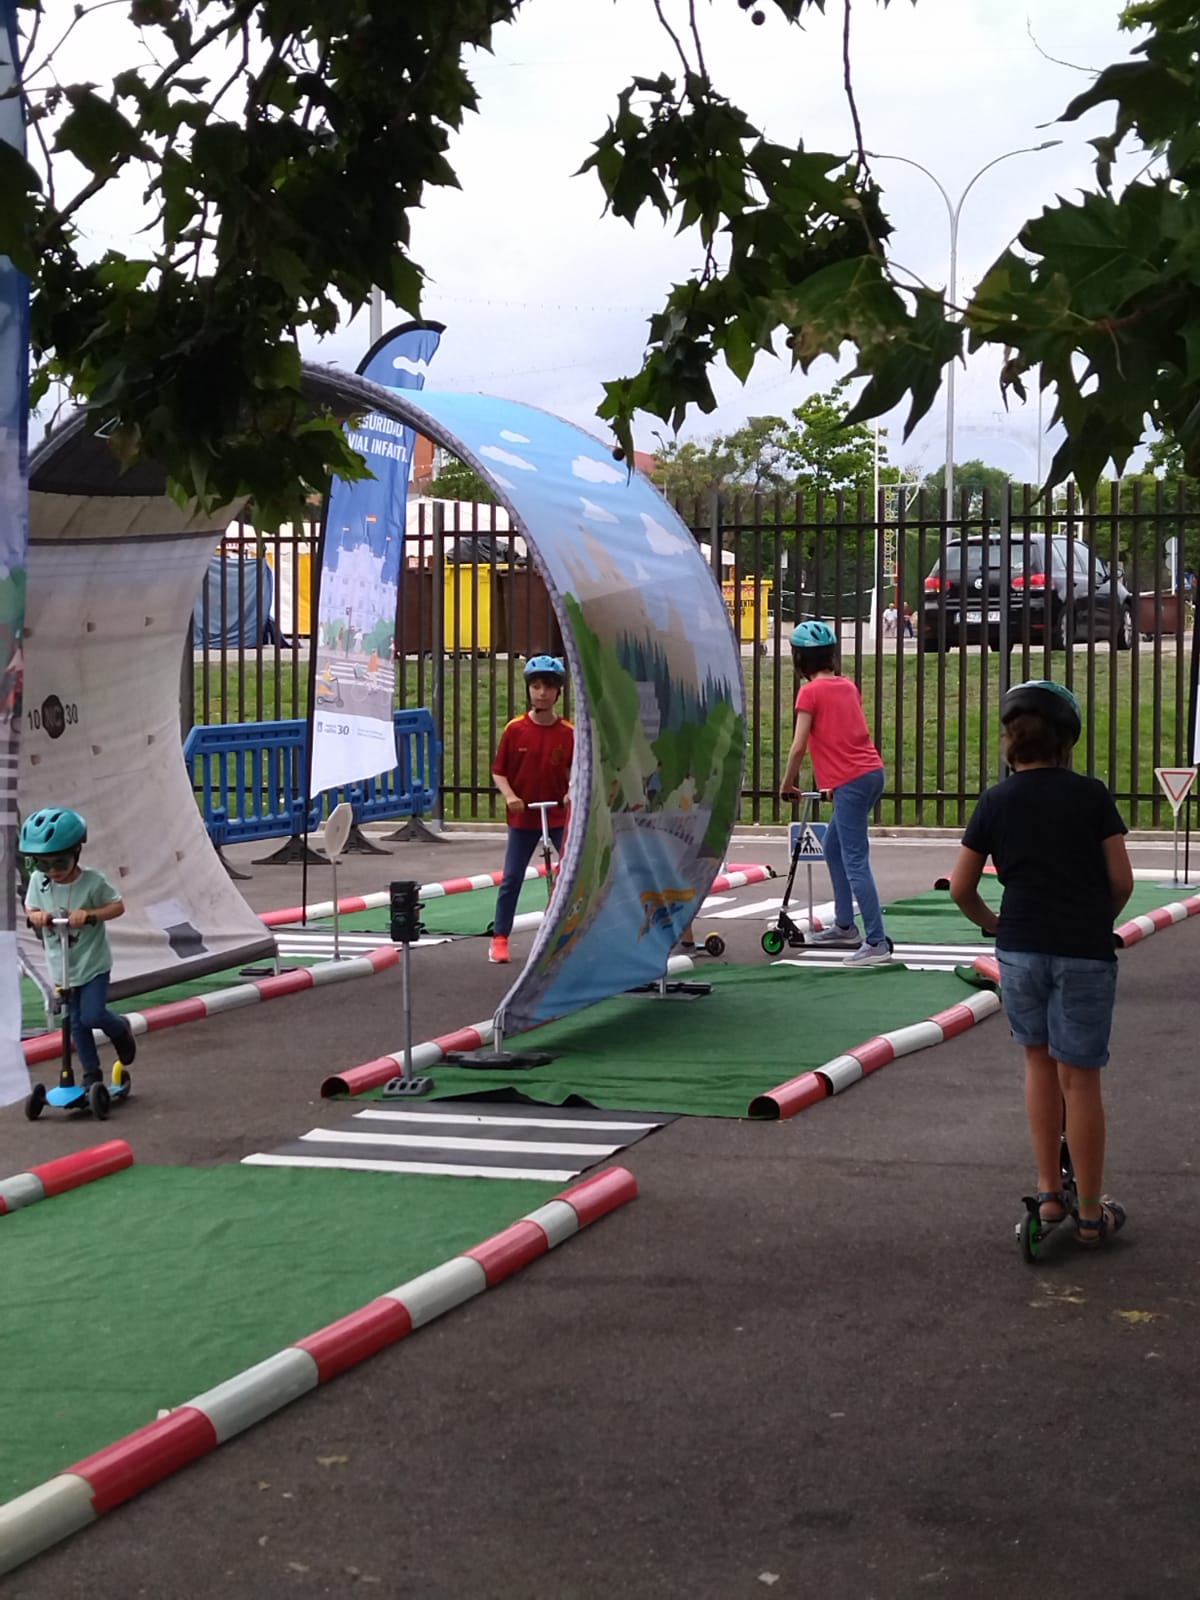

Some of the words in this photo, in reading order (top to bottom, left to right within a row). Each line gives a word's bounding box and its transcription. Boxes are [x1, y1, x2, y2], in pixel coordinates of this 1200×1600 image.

[348, 433, 369, 452] VIAL
[28, 709, 41, 730] 10
[66, 703, 79, 725] 30
[337, 724, 350, 736] 30
